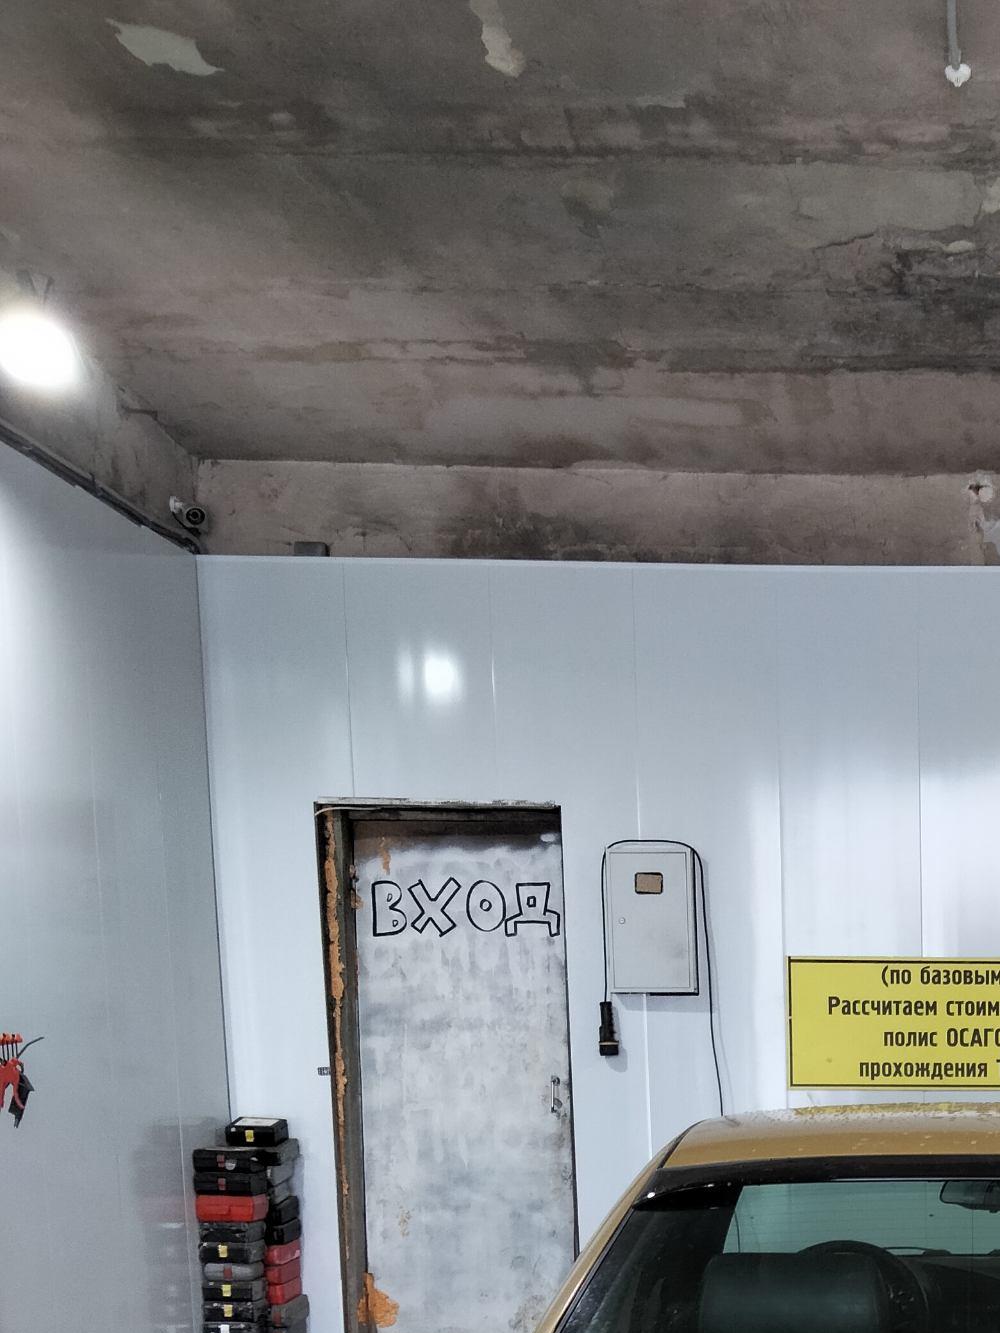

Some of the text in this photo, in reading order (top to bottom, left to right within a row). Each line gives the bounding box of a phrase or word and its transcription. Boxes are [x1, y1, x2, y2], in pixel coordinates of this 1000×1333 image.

[372, 877, 560, 937] ВХОД
[881, 965, 912, 987] (по
[828, 997, 938, 1017] Рассчитаем
[883, 1031, 938, 1048] полис
[859, 1060, 988, 1081] прохождения
